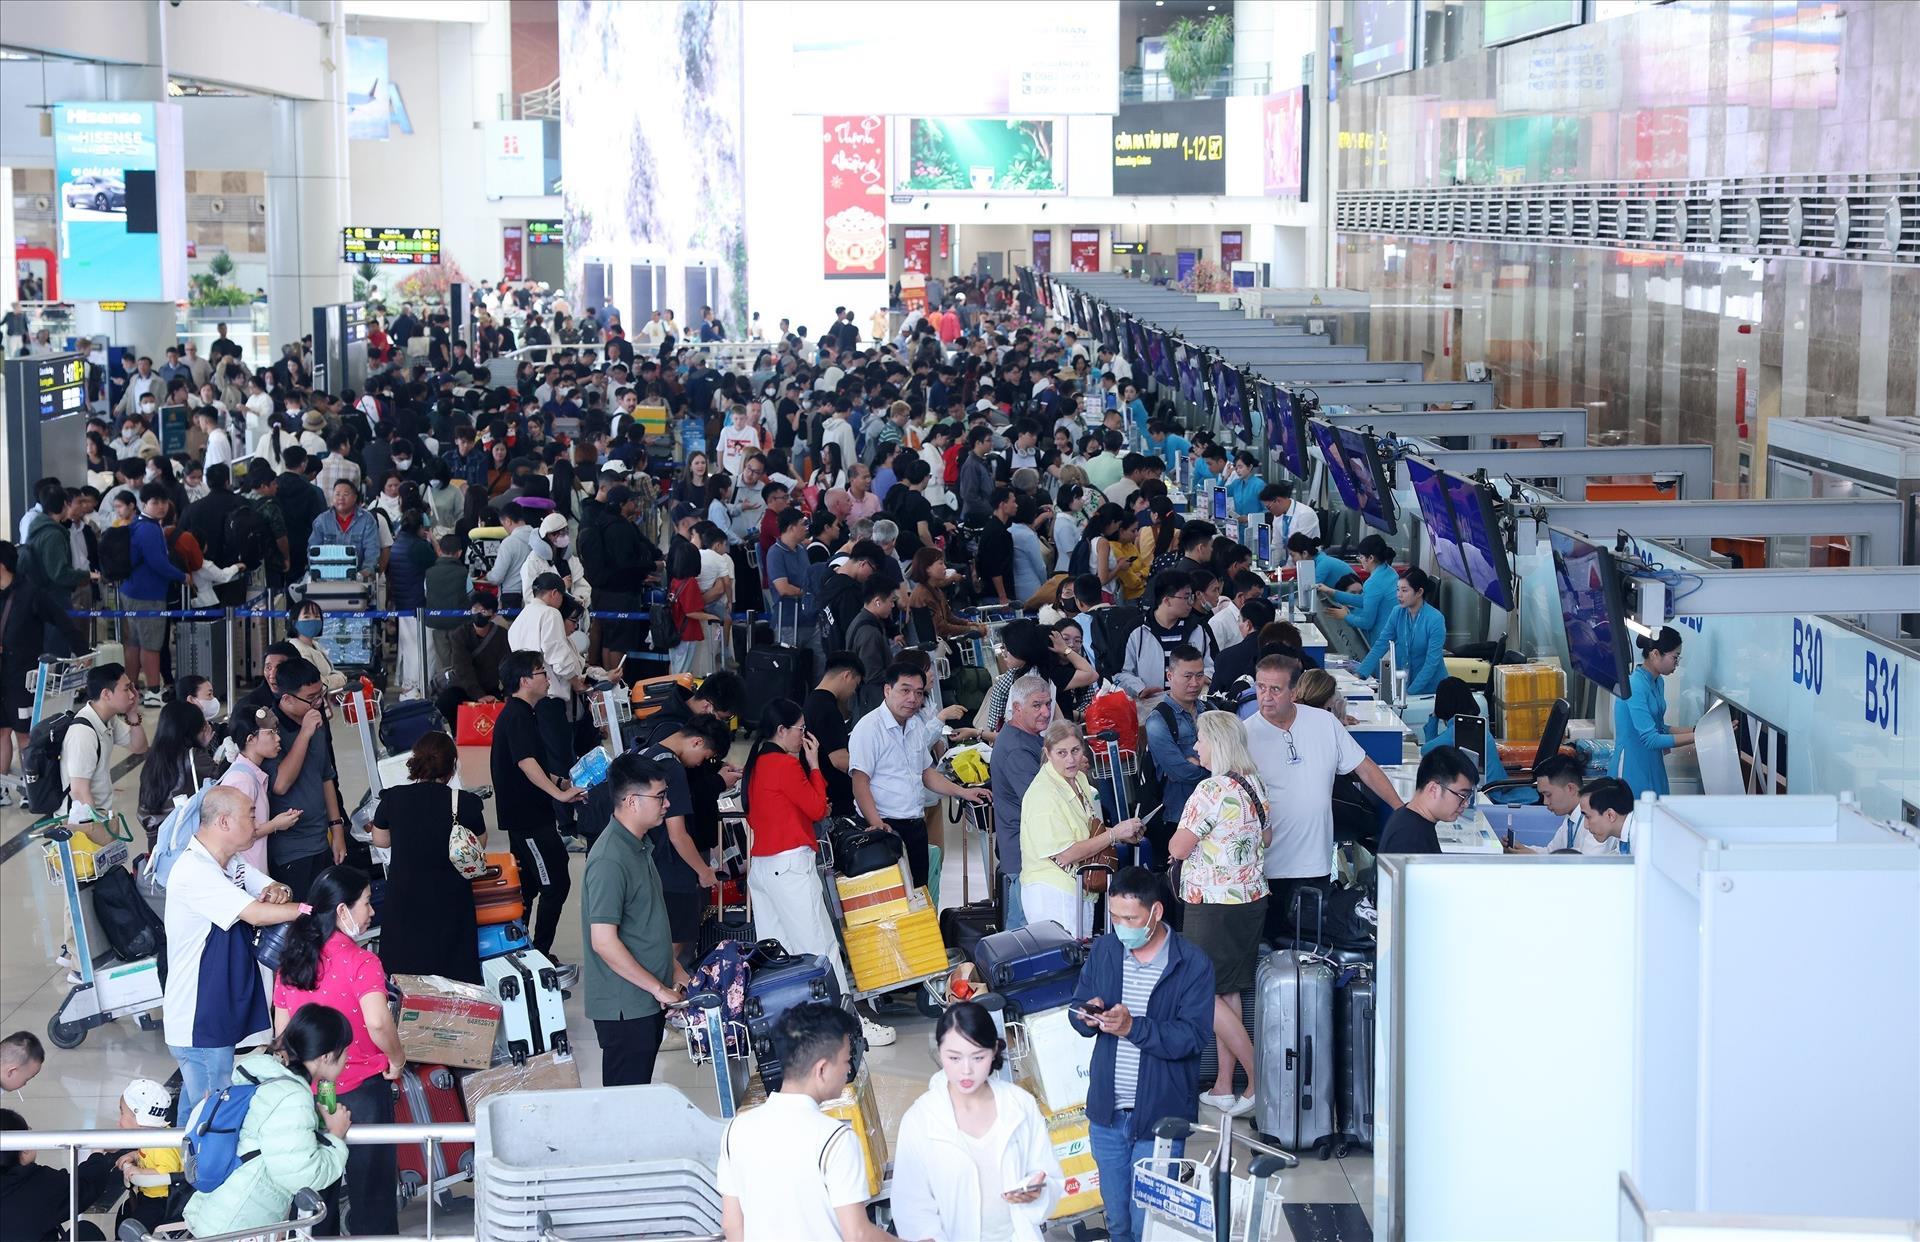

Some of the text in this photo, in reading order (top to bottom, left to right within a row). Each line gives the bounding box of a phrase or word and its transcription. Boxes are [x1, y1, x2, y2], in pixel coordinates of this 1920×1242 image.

[1182, 135, 1207, 161] 1-12
[1793, 617, 1822, 695] B30
[1865, 650, 1898, 735] B31
